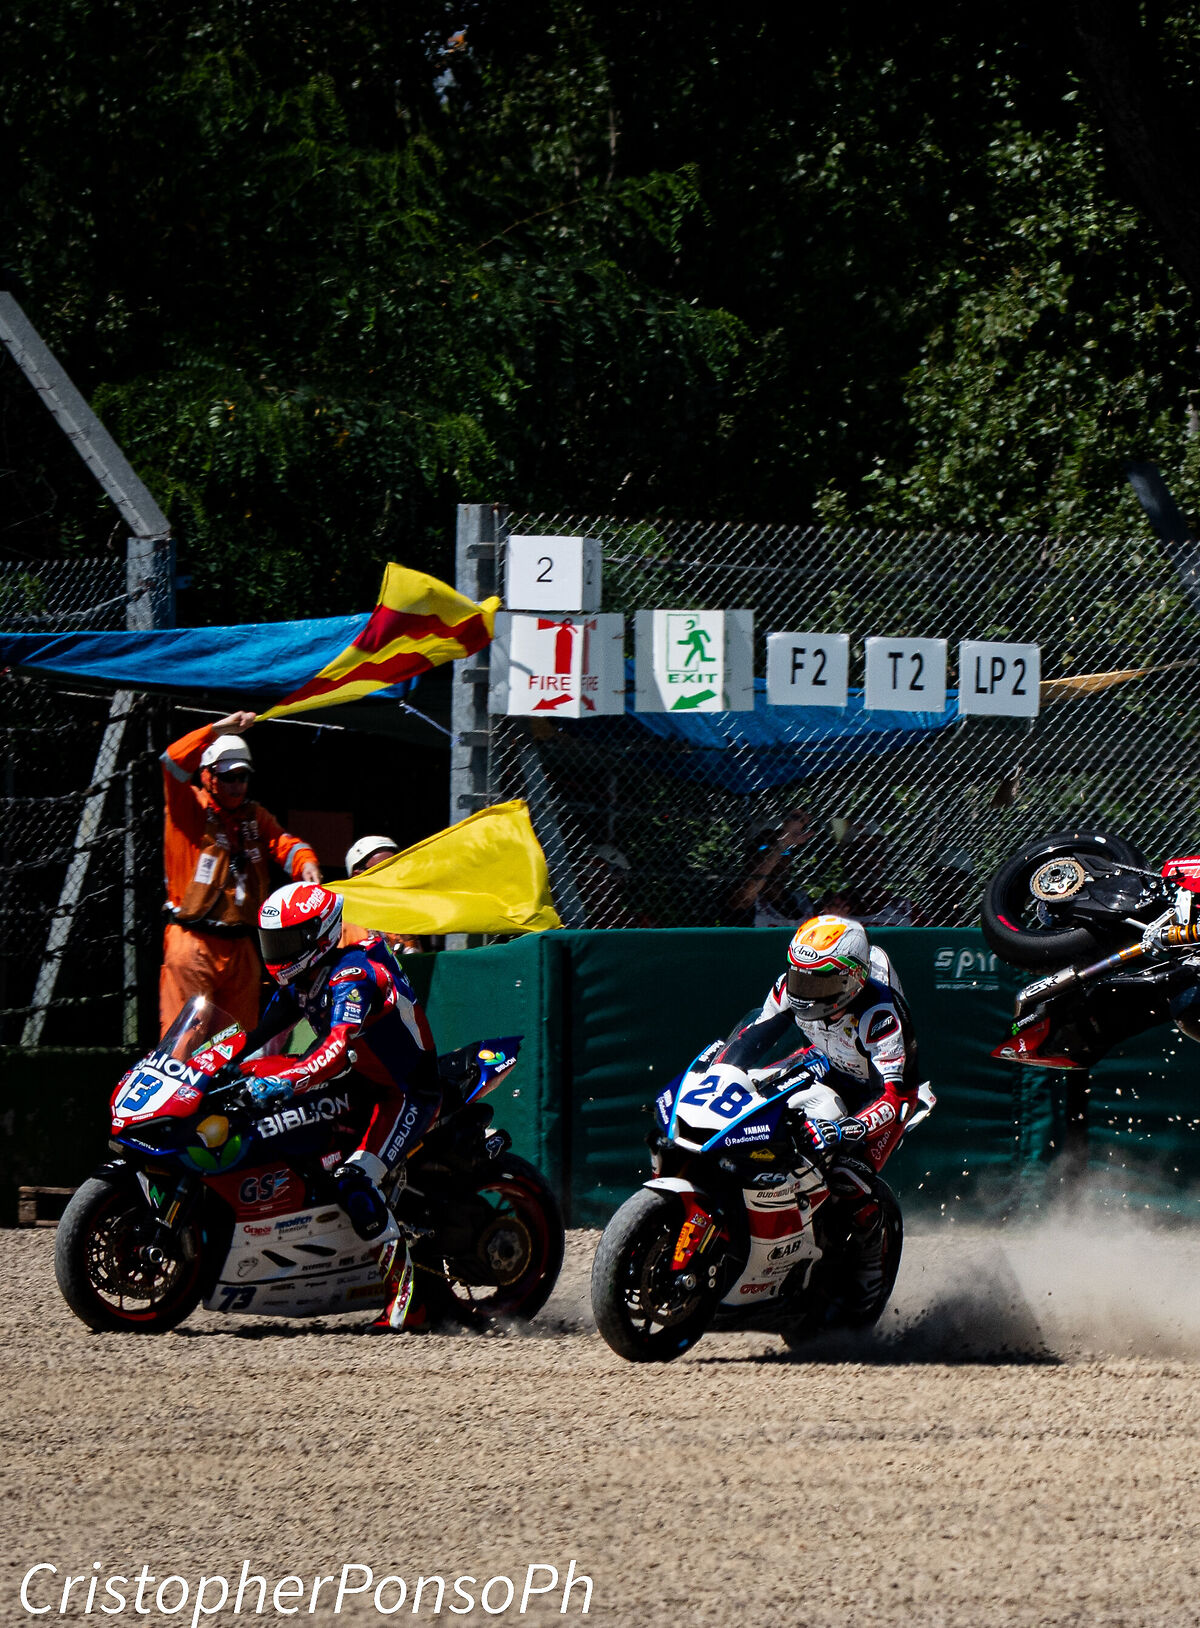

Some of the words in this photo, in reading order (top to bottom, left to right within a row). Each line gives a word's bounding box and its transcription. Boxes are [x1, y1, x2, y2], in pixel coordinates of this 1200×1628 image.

[536, 556, 554, 583] 2
[668, 673, 718, 684] EXIT
[791, 647, 828, 686] F2
[888, 652, 925, 691] T2
[975, 655, 1027, 695] LP2
[528, 675, 572, 691] FIRE
[581, 675, 599, 691] FIRE
[794, 945, 817, 959] Arai
[679, 1075, 753, 1119] 28
[256, 1092, 351, 1139] BIBLION
[387, 1103, 419, 1163] BIBLION
[731, 1133, 770, 1145] Radioshuttle
[743, 1124, 771, 1136] YAMAHA
[217, 1286, 257, 1312] 73
